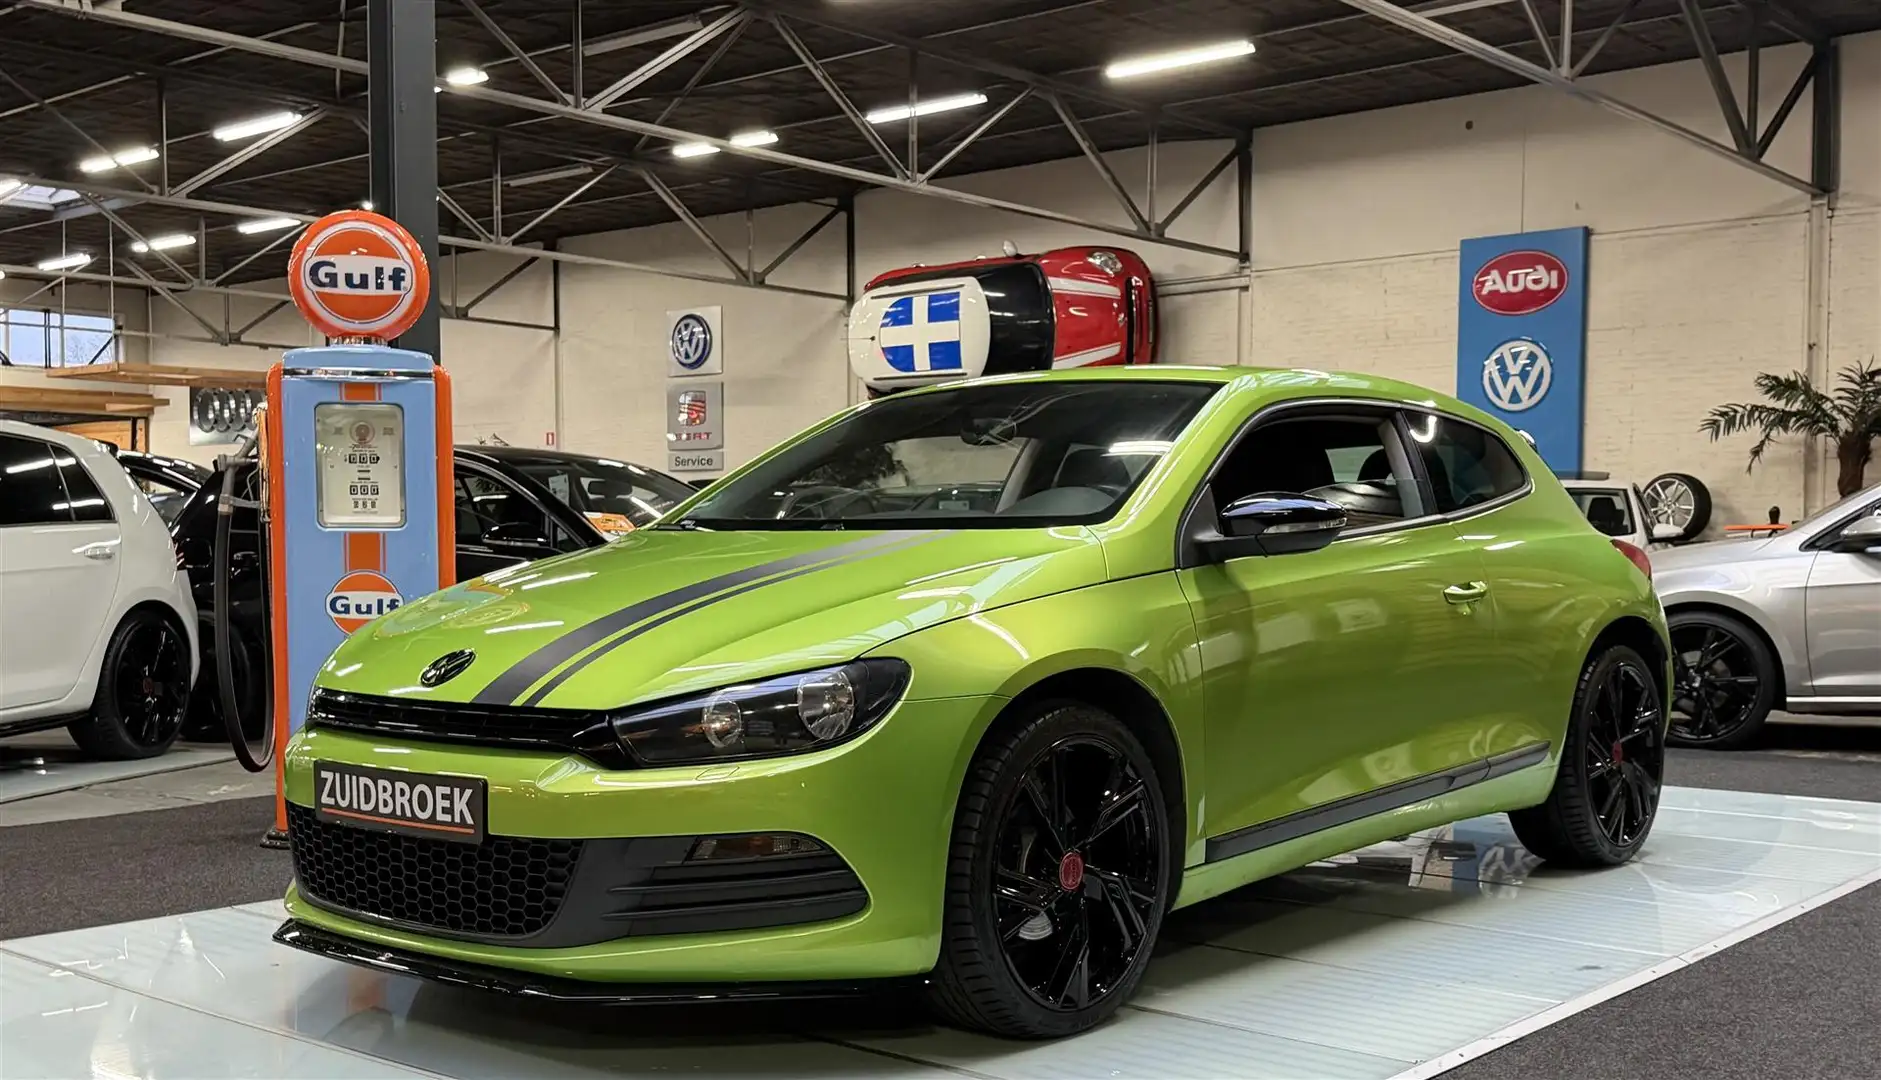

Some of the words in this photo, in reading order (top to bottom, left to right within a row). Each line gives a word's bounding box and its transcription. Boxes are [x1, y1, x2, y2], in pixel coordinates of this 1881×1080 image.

[309, 260, 406, 291] Gulf
[674, 455, 713, 467] Service
[329, 595, 400, 616] Gulf
[320, 770, 474, 825] ZUIDBROEK
